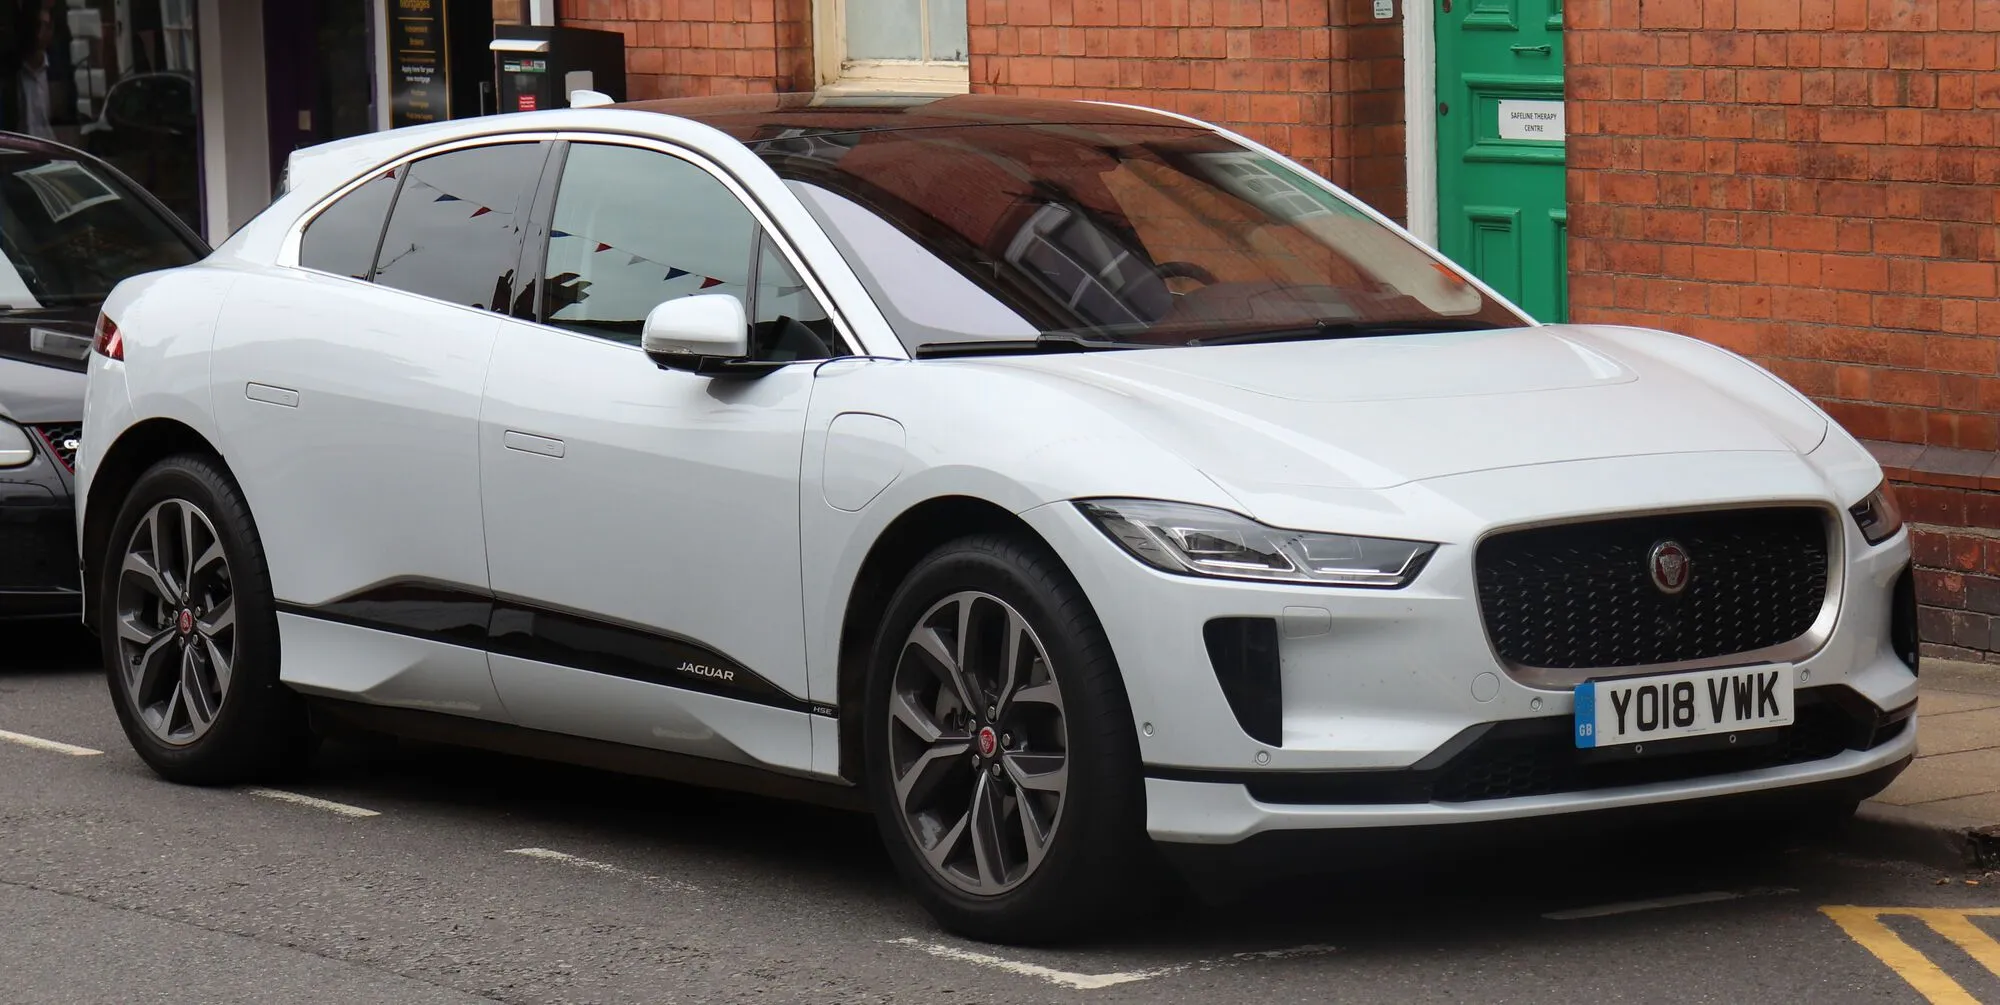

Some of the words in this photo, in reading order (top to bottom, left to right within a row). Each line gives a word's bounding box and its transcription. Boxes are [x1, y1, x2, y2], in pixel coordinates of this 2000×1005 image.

[1510, 112, 1533, 120] SAFELINE
[1534, 112, 1557, 121] THERAPY
[1524, 124, 1544, 132] CENTRE
[676, 661, 735, 681] JAGUAR
[1610, 681, 1695, 735] YO18
[1707, 671, 1780, 724] VWK
[813, 706, 832, 715] HSE
[1579, 723, 1592, 737] GB
